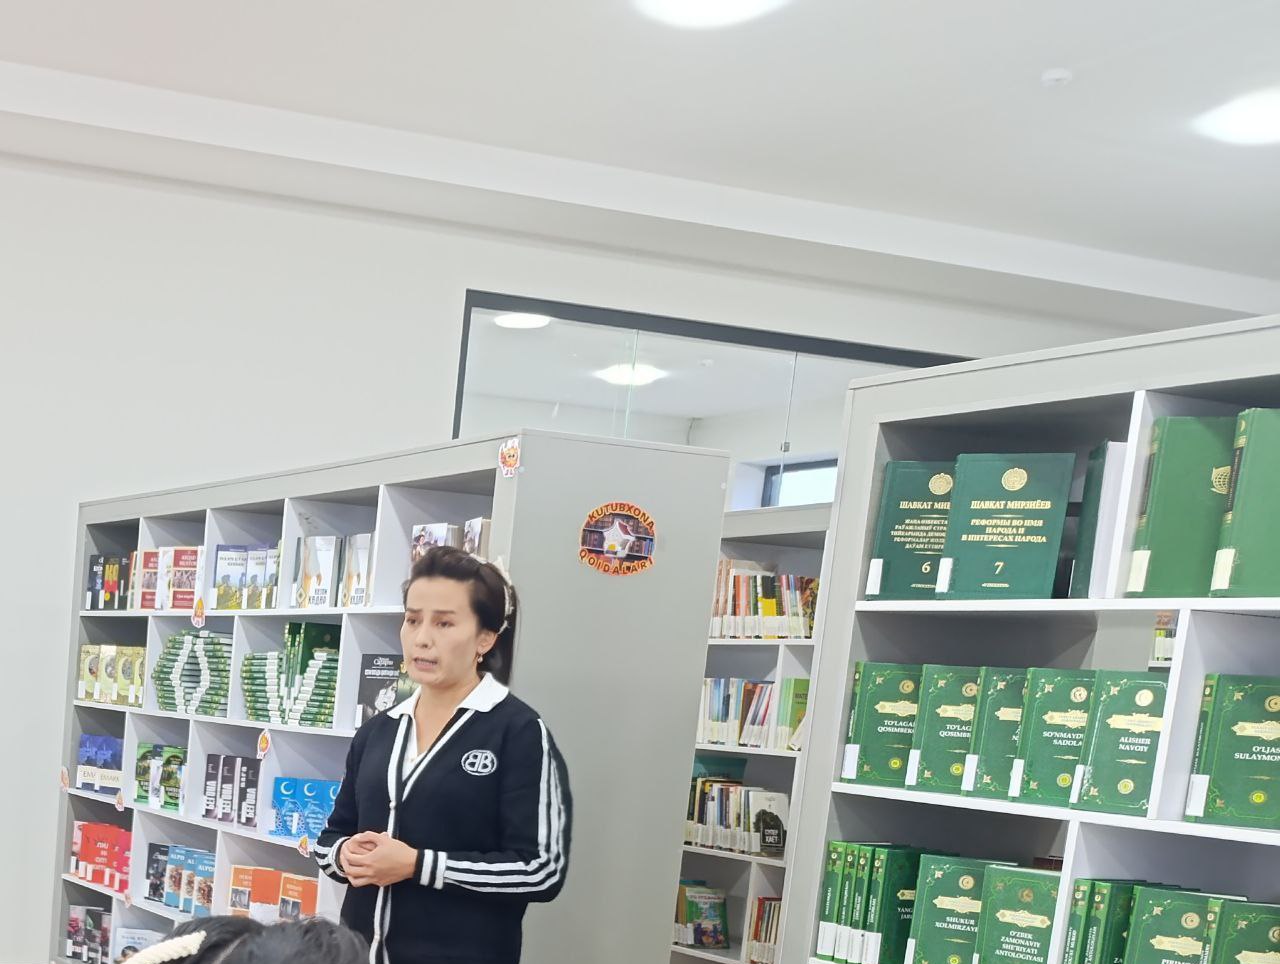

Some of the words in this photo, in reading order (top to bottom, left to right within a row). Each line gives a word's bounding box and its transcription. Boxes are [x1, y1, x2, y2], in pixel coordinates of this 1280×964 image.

[970, 500, 1006, 509] ШАВКАТ
[588, 502, 655, 530] KUTUBXONA
[1024, 519, 1044, 527] ИМЯ
[967, 534, 1014, 542] ИНТЕРЕСАХ
[1014, 535, 1047, 543] НАРОДА
[579, 548, 654, 575] QOIDALARI
[922, 561, 931, 573] 6
[994, 561, 1004, 575] 7
[1119, 736, 1151, 745] ALISHER
[1118, 743, 1150, 752] NAVOIY
[1252, 745, 1280, 754] O'LJAS
[945, 916, 975, 925] SHUKUR
[1009, 930, 1033, 939] O'ZBEK
[1000, 936, 1041, 948] ZAMONAVIY
[995, 949, 1044, 963] ANTOLOGIYASI
